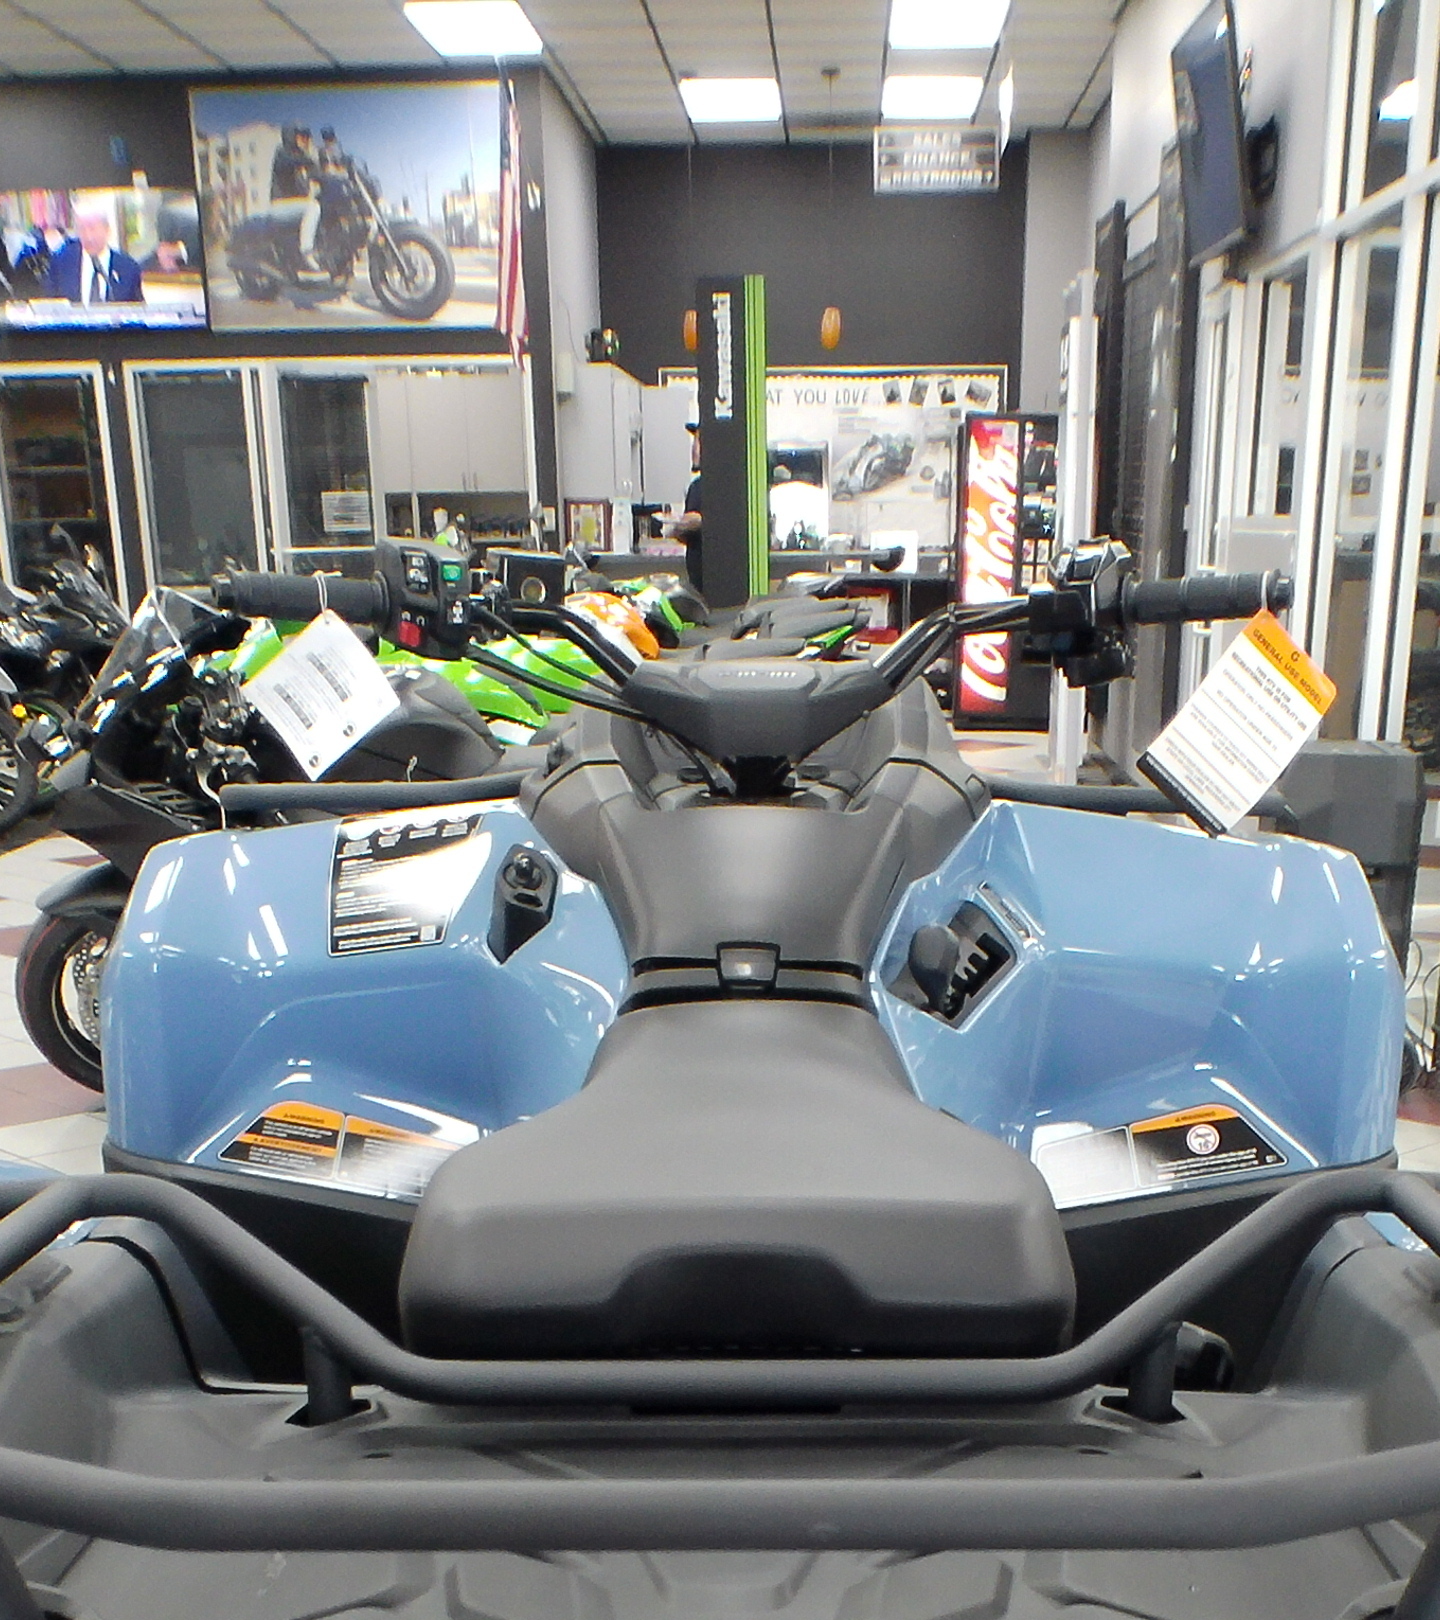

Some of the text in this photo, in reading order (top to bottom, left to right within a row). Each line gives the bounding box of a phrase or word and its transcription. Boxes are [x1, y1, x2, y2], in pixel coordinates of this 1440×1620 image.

[712, 292, 732, 419] Kawasaki
[794, 389, 826, 405] YOU
[1253, 629, 1322, 705] GENERAL USE MODEL
[1291, 651, 1300, 662] G
